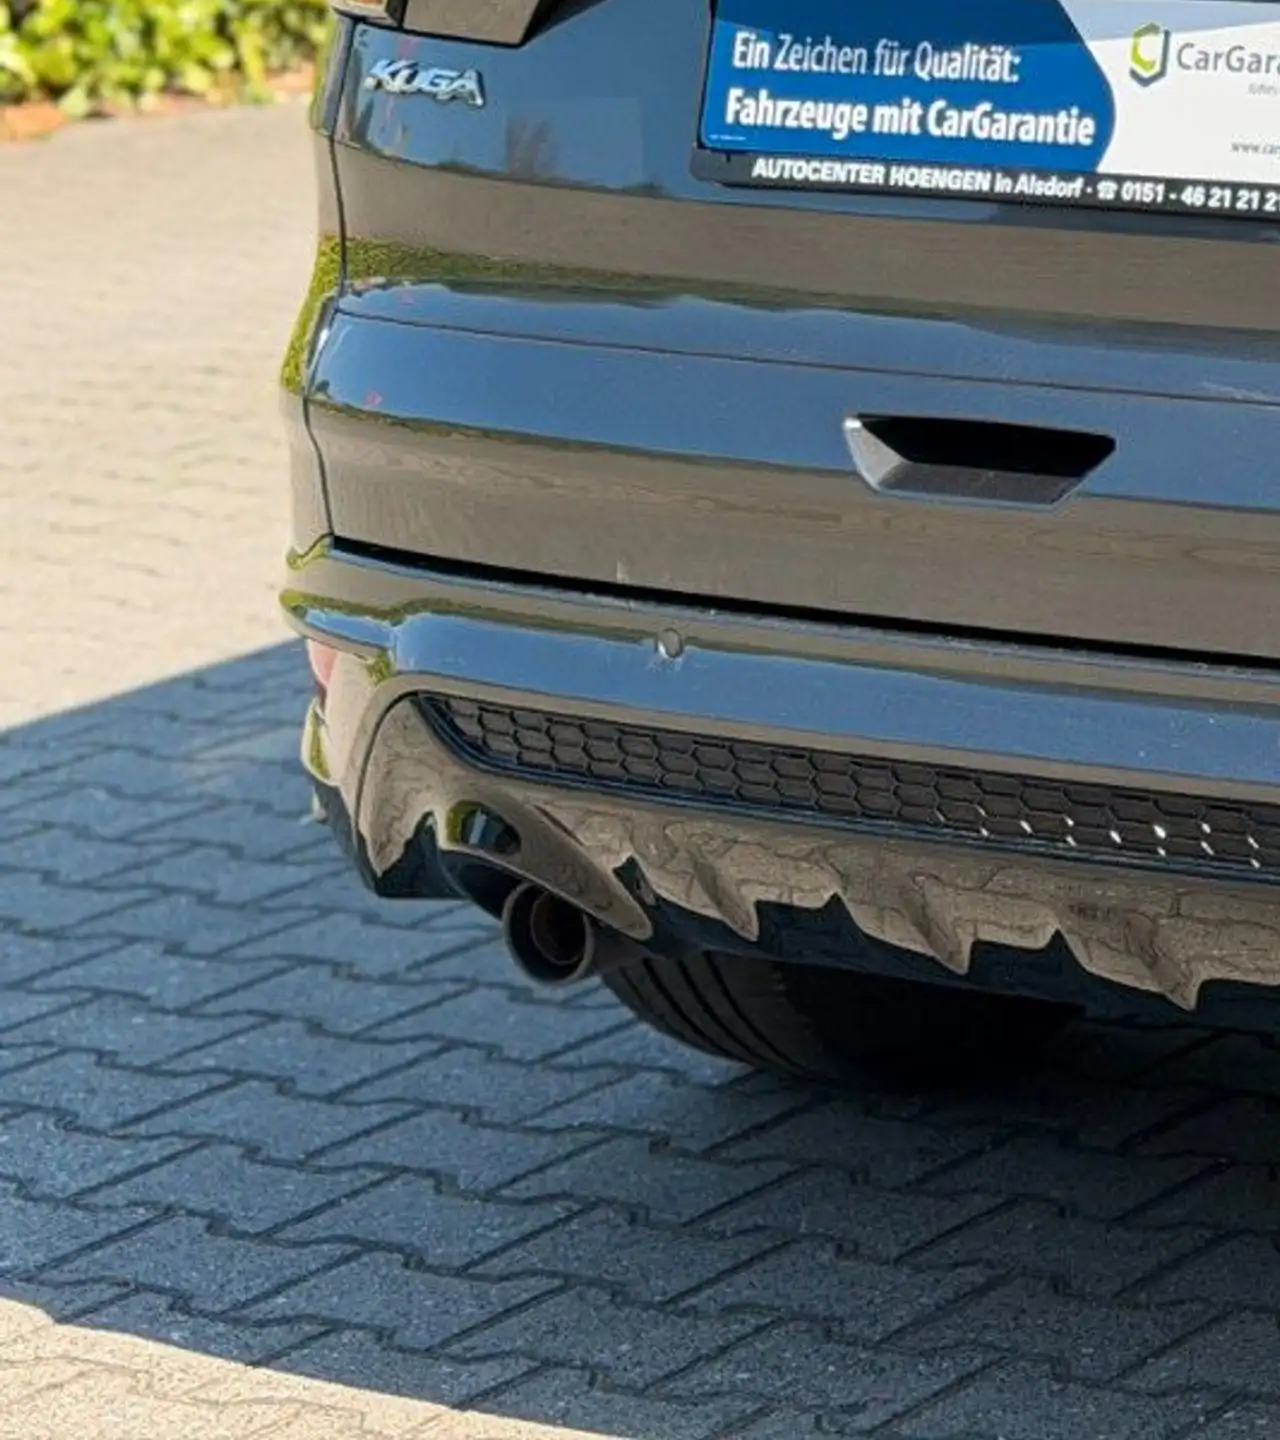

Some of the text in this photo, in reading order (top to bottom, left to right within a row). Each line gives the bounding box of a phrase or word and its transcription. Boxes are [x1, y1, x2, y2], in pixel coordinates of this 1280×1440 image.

[364, 58, 484, 107] KUGA
[732, 31, 1021, 83] Ein Zeichen für Qualität:
[725, 87, 1096, 146] Fahrzeuge mit CarGarantie
[751, 157, 885, 186] AUTOCENTER
[889, 166, 991, 192] HOENGEN
[1014, 174, 1085, 199] Alsdorf
[1120, 180, 1165, 203] 0151
[1180, 184, 1205, 207] 46
[1207, 186, 1231, 208] 21
[1235, 188, 1259, 211] 21
